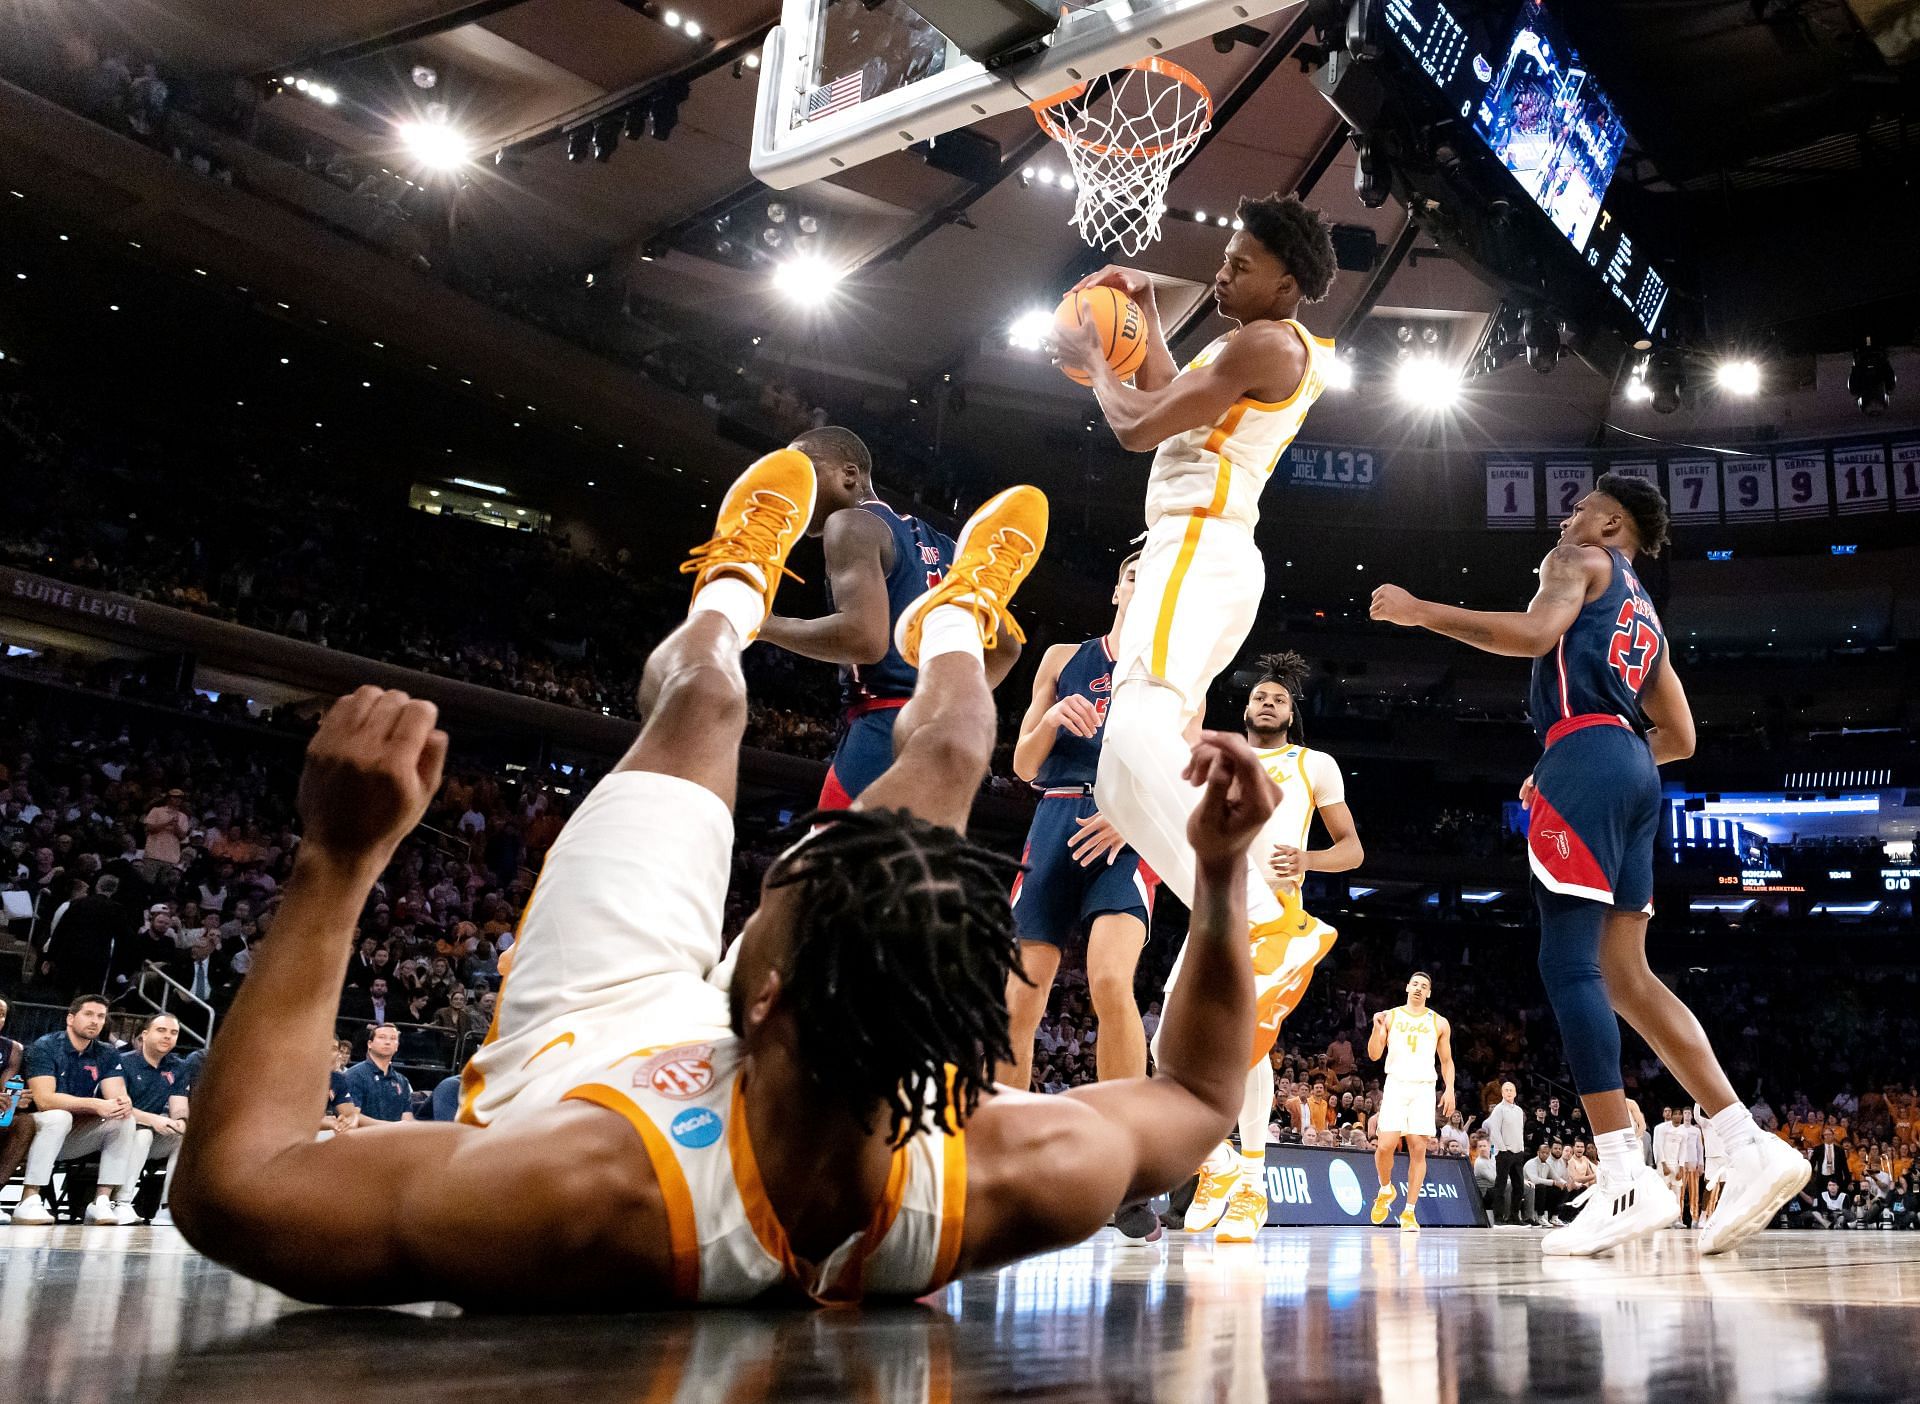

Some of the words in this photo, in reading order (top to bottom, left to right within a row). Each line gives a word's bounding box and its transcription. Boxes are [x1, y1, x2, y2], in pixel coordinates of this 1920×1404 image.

[1461, 100, 1471, 117] 8
[1599, 209, 1612, 231] T
[1587, 247, 1600, 266] 15
[1291, 448, 1319, 464] BILLY
[1899, 449, 1920, 460] MESS
[1292, 463, 1317, 480] JOEL
[1322, 450, 1374, 483] 133
[1553, 470, 1585, 480] LEETCH
[1791, 471, 1813, 503] 9
[1845, 465, 1877, 498] 11
[1904, 462, 1920, 496] 1
[1503, 481, 1518, 513] 1
[1560, 481, 1579, 513] 2
[1683, 477, 1703, 509] 7
[1739, 475, 1759, 507] 9
[14, 580, 73, 608] SUITE
[79, 596, 137, 624] LEVEL
[1608, 598, 1660, 693] 23
[1719, 876, 1738, 884] 9:53
[1885, 878, 1910, 890] 0/0
[1396, 1021, 1429, 1034] Vols
[1407, 1034, 1417, 1053] 4
[1399, 1182, 1459, 1199] NSSAN
